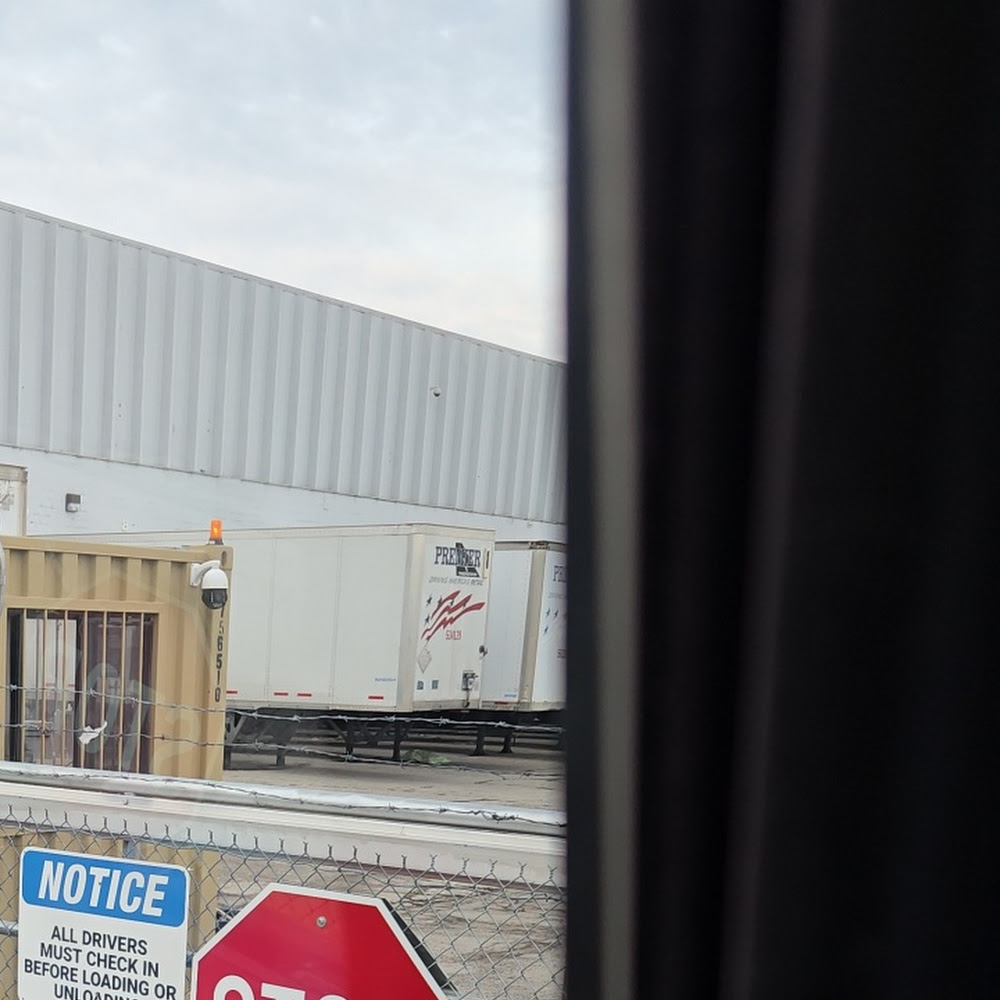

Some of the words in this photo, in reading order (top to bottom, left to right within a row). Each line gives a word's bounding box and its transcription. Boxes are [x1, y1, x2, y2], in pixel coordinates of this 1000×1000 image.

[38, 860, 169, 917] NOTICE
[51, 925, 78, 944] ALL
[83, 930, 148, 955] DRIVERS
[24, 958, 78, 983] BEFORE
[83, 969, 149, 996] LOADING
[154, 984, 177, 1000] OR
[40, 942, 82, 964] MUST
[86, 951, 138, 975] CHECK
[142, 960, 159, 978] IN
